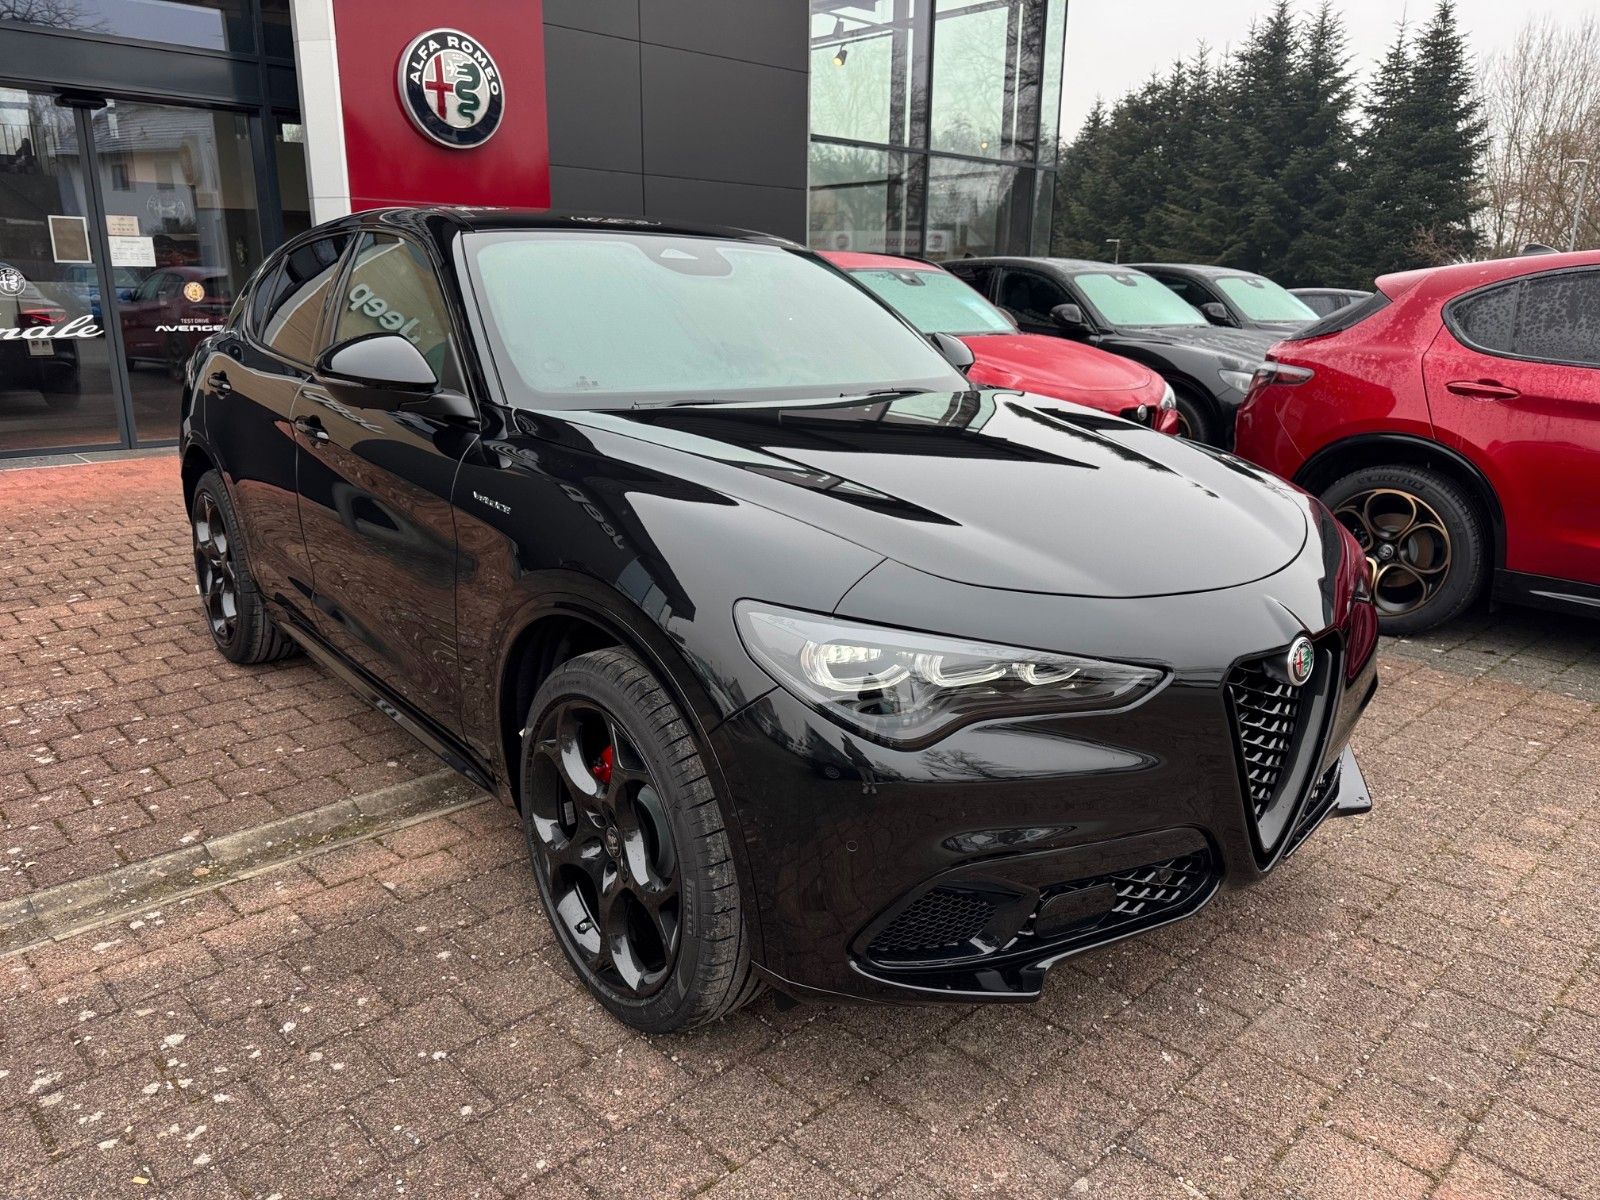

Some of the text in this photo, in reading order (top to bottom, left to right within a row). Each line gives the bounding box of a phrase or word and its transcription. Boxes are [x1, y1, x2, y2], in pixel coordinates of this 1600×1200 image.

[410, 35, 499, 95] ALFA ROMEO
[0, 314, 104, 340] nale
